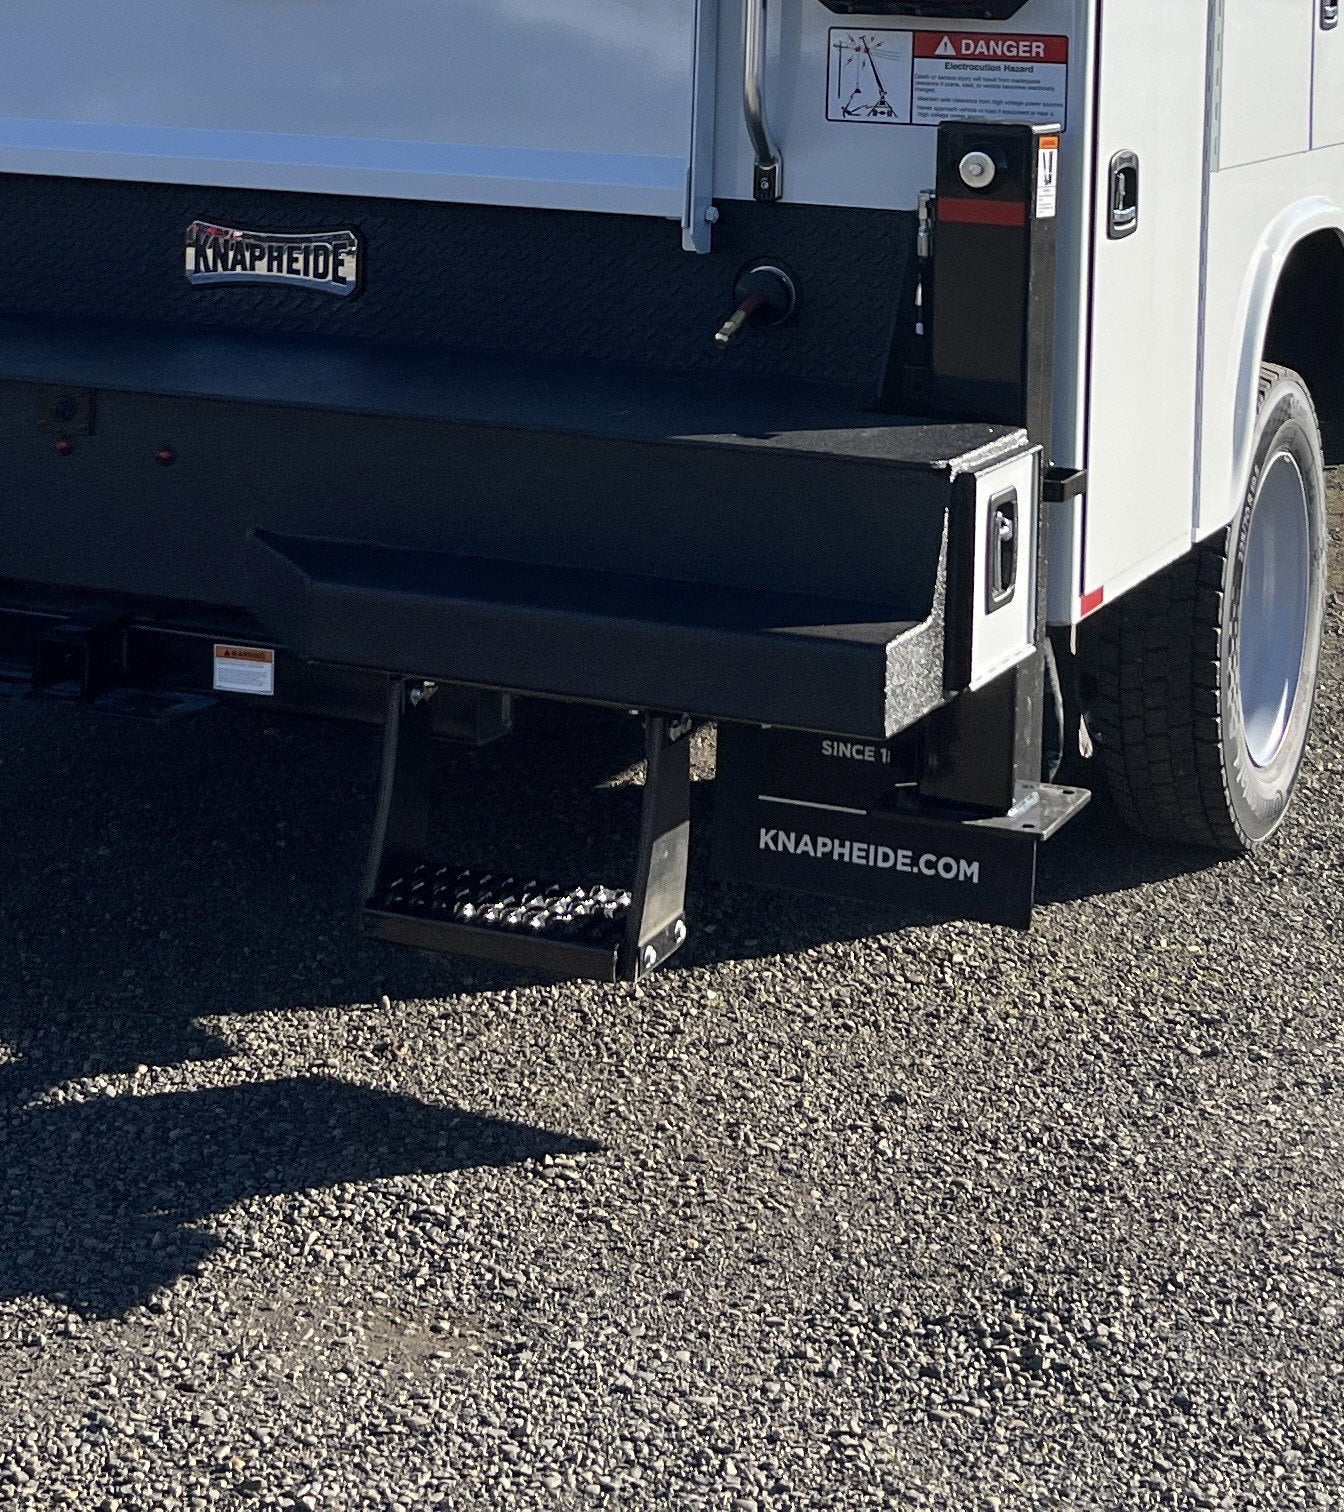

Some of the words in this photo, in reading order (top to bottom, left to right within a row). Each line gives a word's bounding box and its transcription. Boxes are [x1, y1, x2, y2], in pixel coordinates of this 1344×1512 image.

[961, 39, 1046, 58] DANGER
[944, 62, 1001, 72] Electrocution
[1003, 65, 1034, 74] Hazard
[192, 232, 348, 285] KNAPHEIDE
[822, 740, 875, 762] SINCE
[759, 828, 980, 884] KNAPHEIDE.COM
